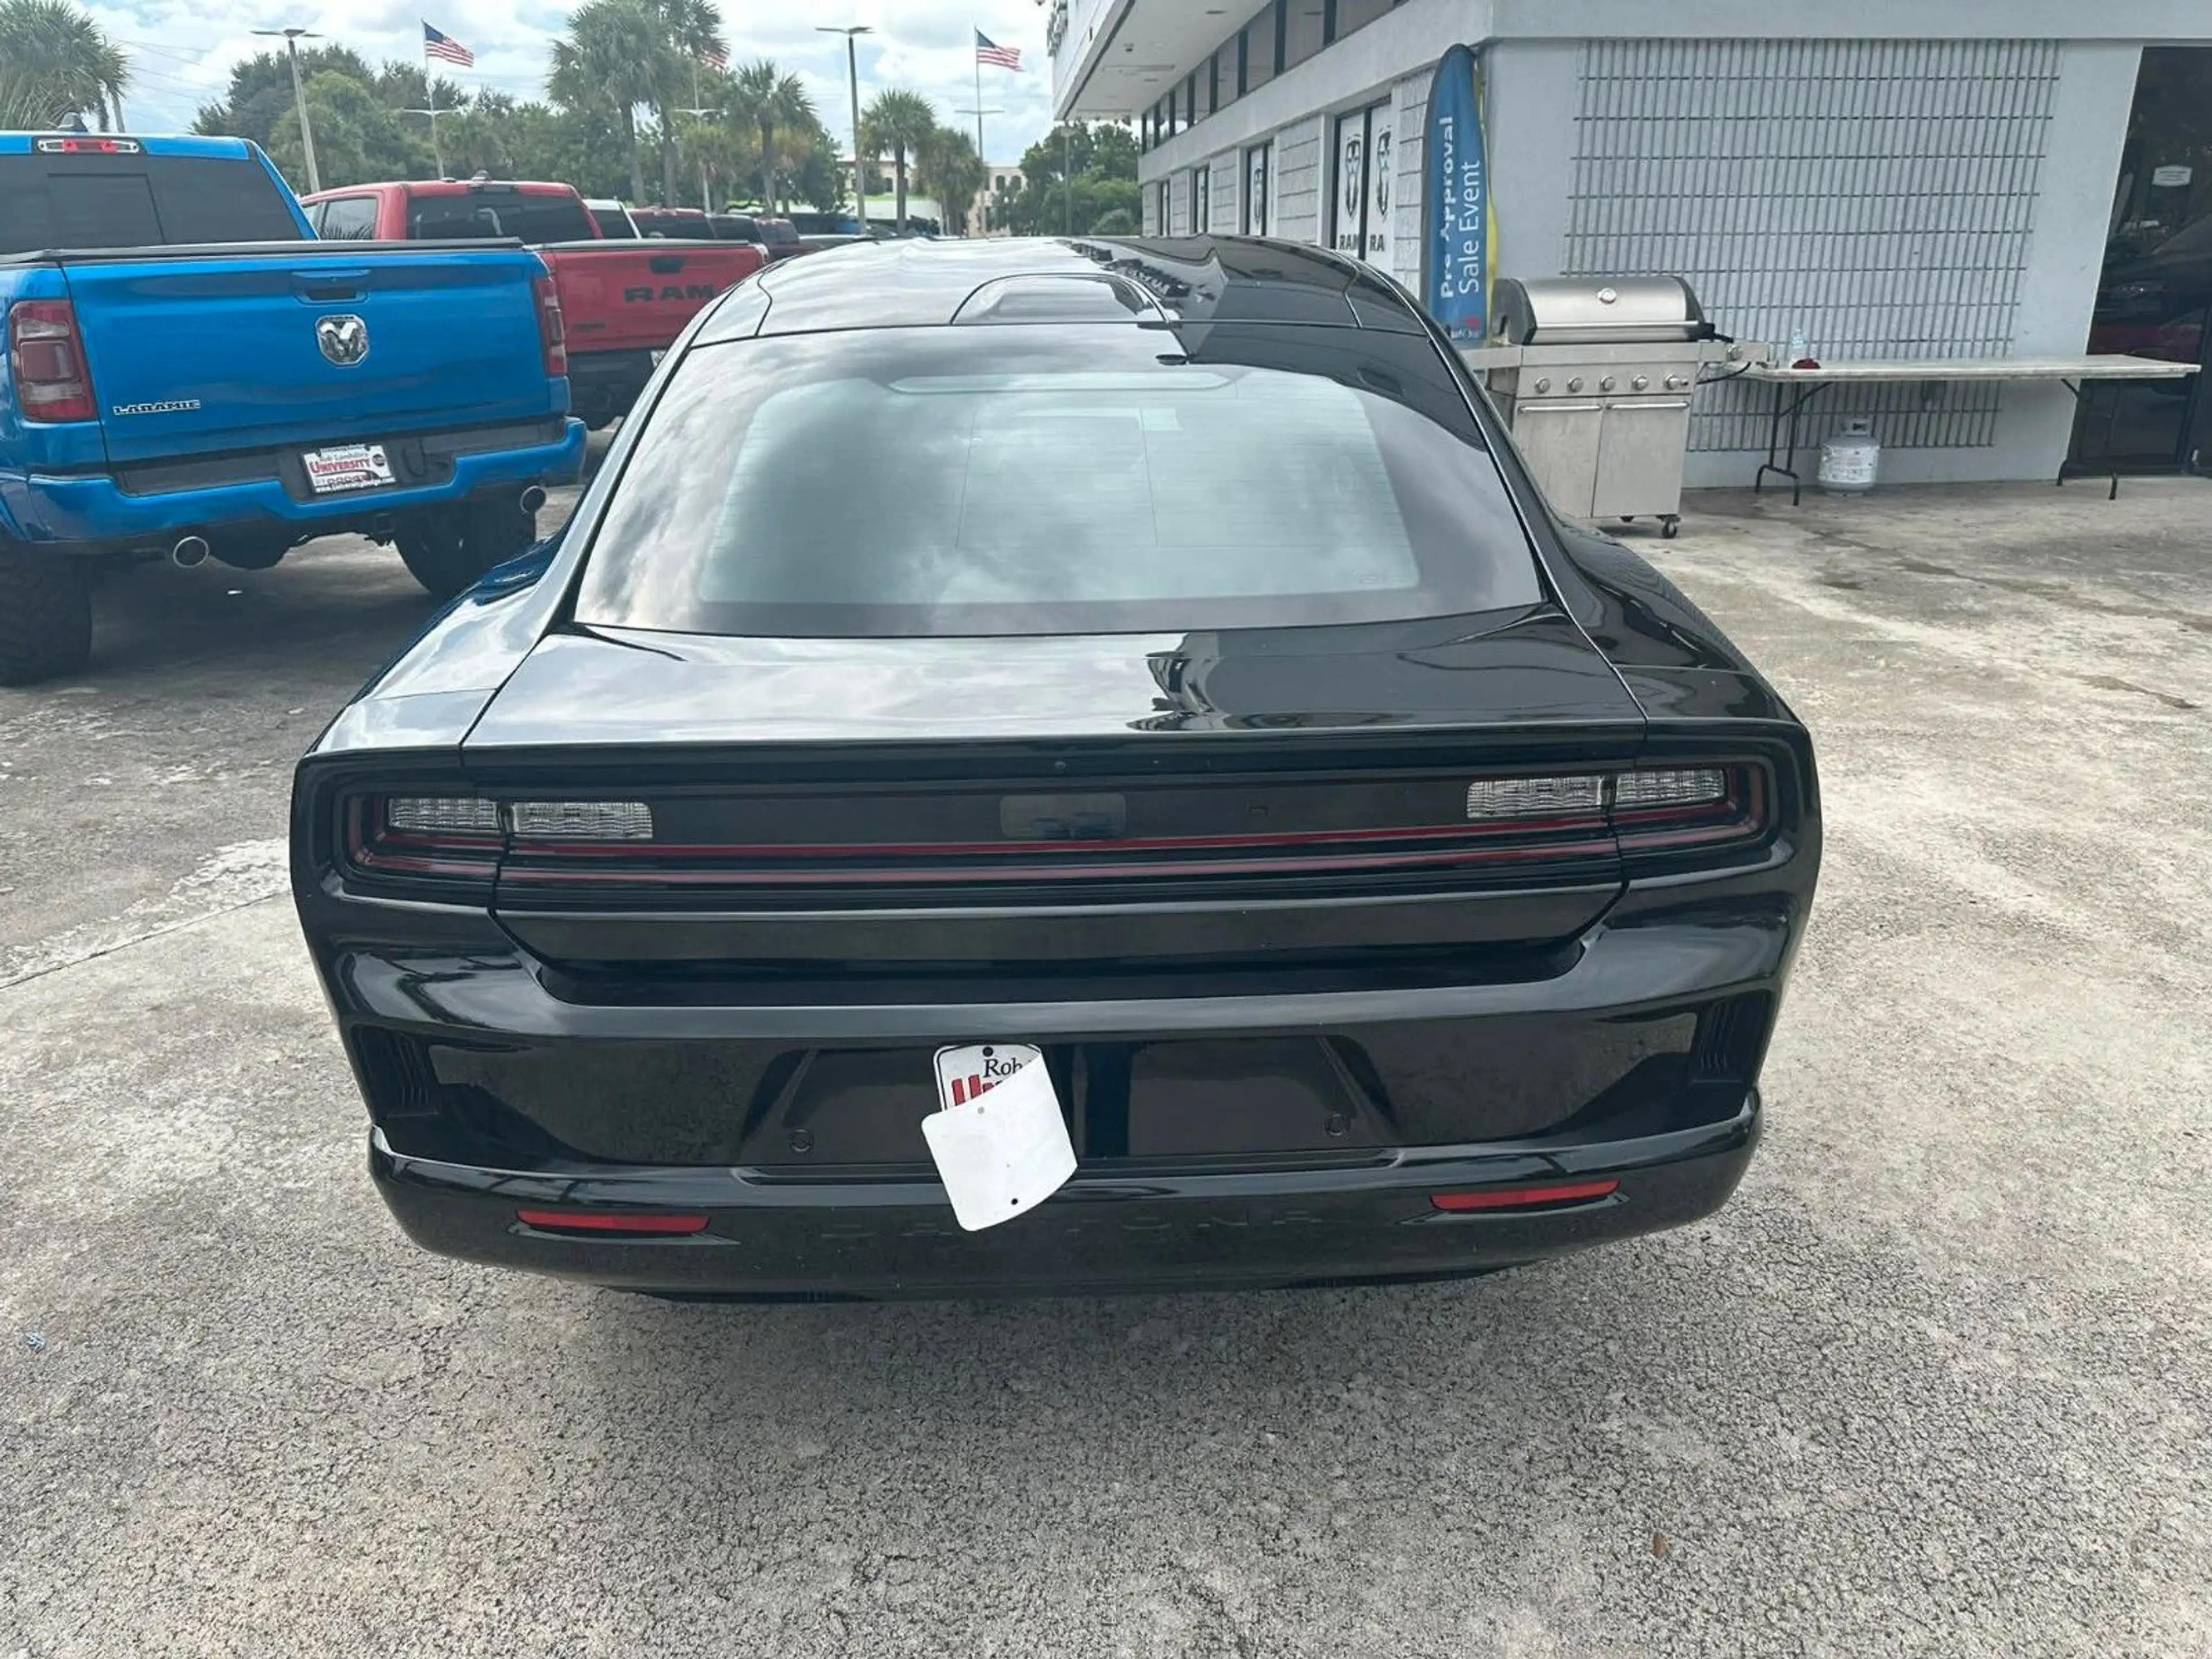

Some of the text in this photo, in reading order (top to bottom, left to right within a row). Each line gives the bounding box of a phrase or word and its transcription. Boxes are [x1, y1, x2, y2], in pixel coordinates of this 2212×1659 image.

[1440, 116, 1457, 242] Approval
[1457, 160, 1480, 294] Sale Event
[624, 284, 714, 303] RAM
[113, 399, 201, 415] LARAMIE
